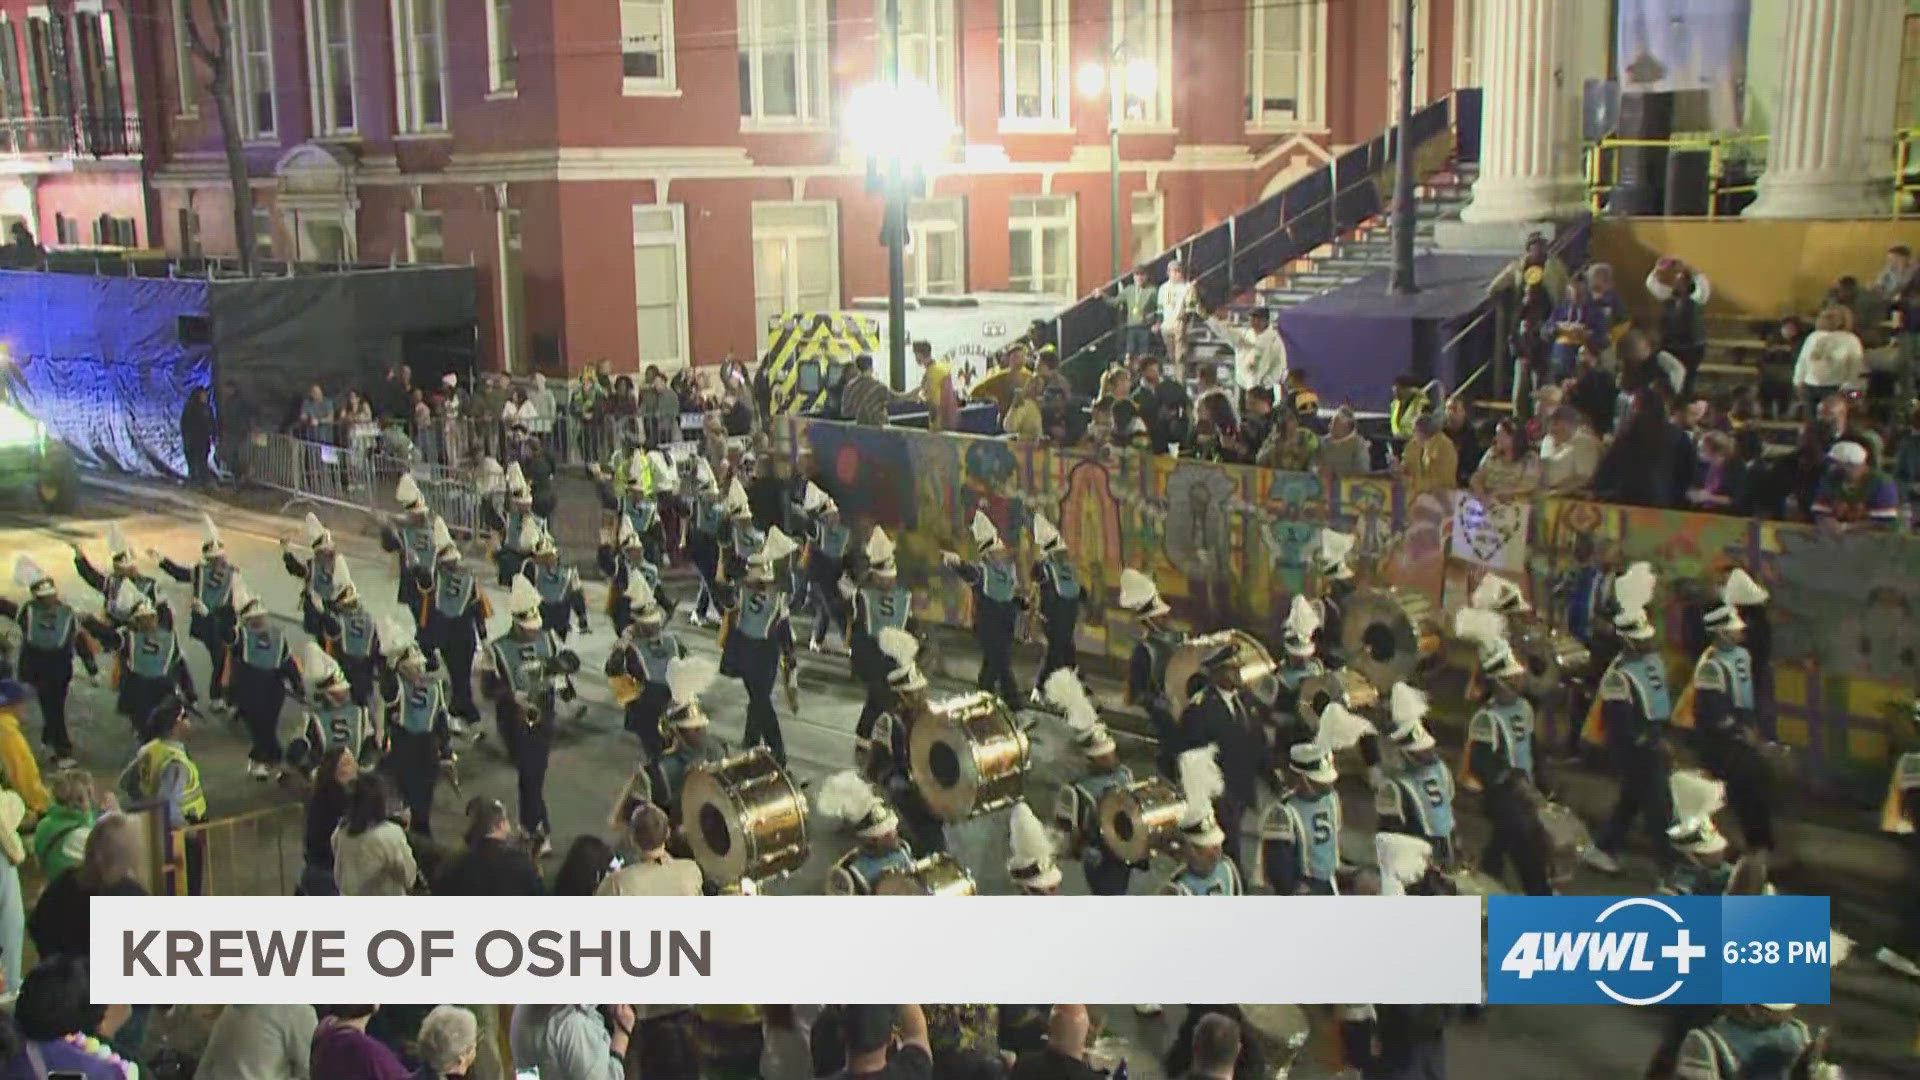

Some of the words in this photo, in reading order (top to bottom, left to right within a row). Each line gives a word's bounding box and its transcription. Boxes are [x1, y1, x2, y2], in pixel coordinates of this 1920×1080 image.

[879, 597, 895, 617] S
[350, 618, 365, 638] S
[1647, 664, 1662, 691] S
[1734, 656, 1747, 683] S
[411, 687, 428, 709] S
[331, 718, 351, 744] S
[1511, 713, 1525, 742] S
[1423, 778, 1443, 808] S
[1312, 811, 1331, 845] S
